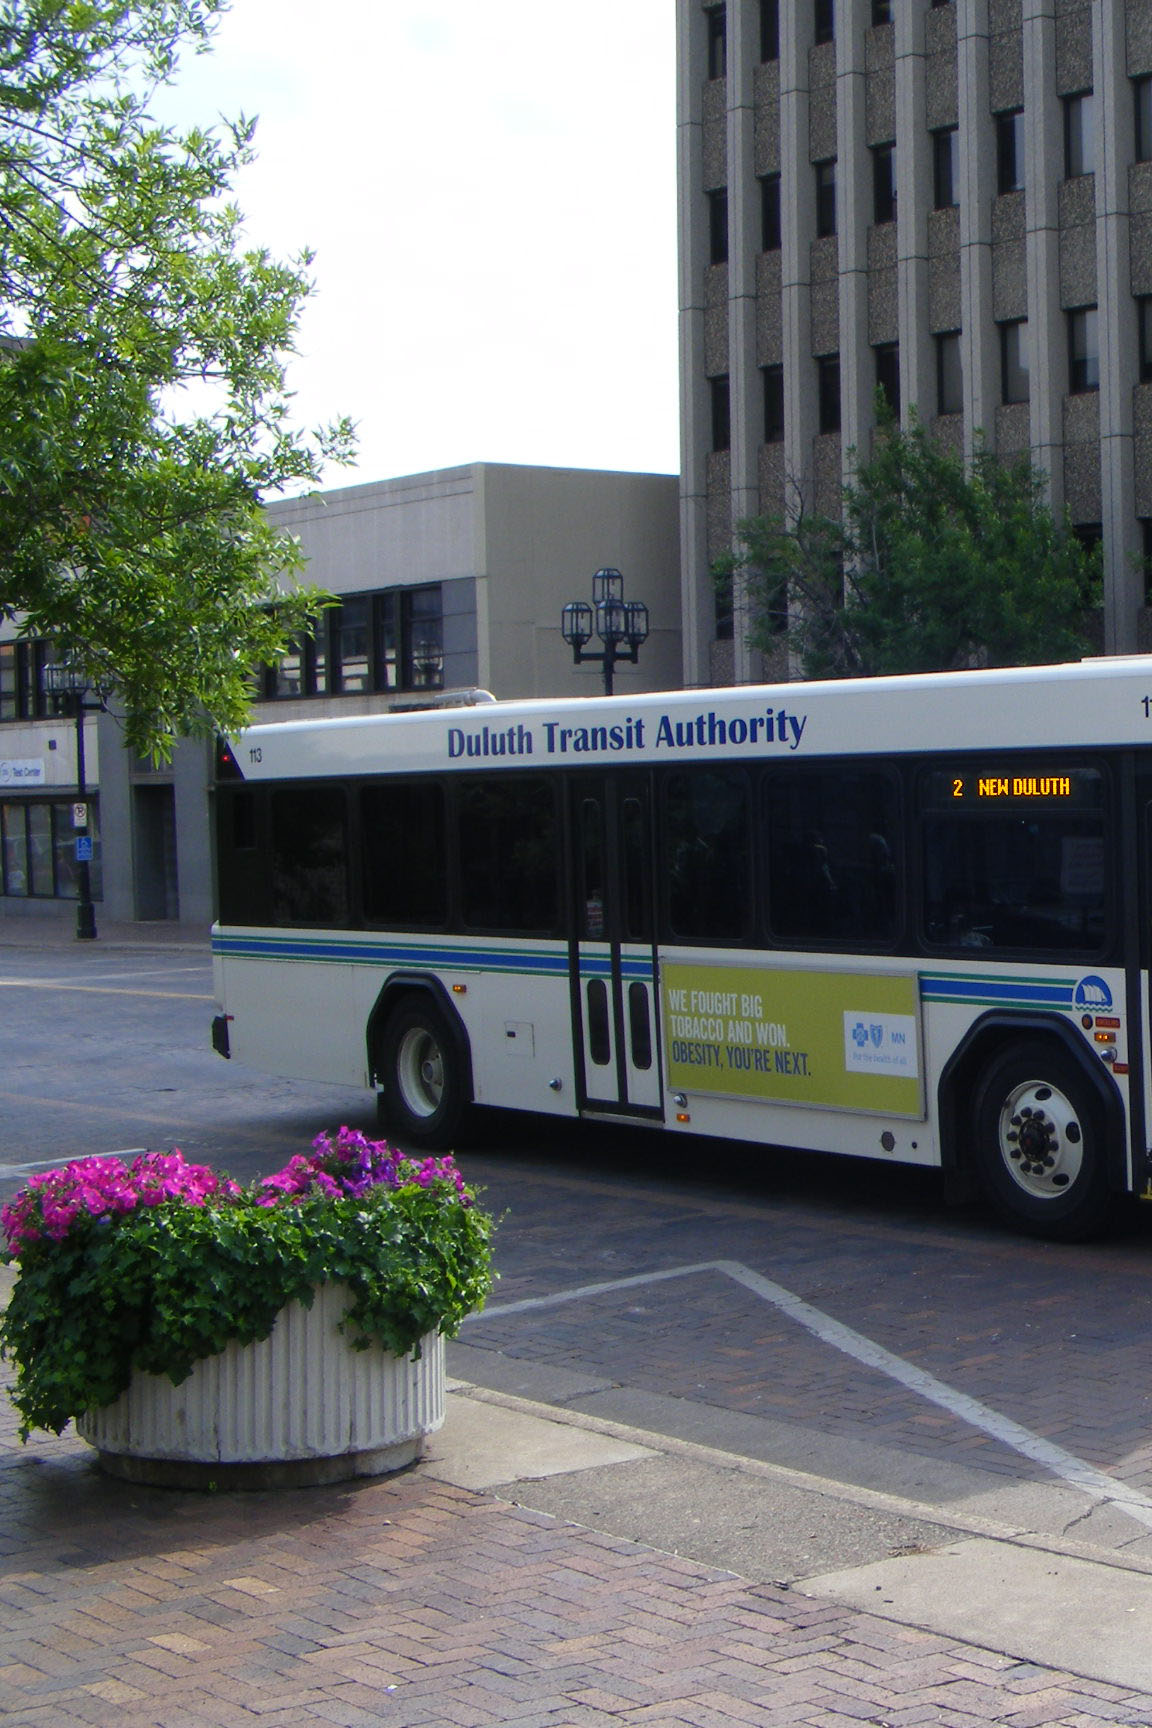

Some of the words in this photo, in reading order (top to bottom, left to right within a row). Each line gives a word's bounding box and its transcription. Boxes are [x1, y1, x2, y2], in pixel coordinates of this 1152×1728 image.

[447, 724, 532, 758] Duluth
[542, 717, 645, 754] Transit
[656, 708, 807, 750] Authority
[249, 747, 262, 763] 113
[953, 779, 963, 797] 2
[978, 778, 1009, 796] NEW
[1013, 777, 1070, 796] DULUTH
[669, 989, 688, 1012] WE
[690, 991, 737, 1016] FOUGHT
[741, 994, 763, 1018] BIG
[670, 1015, 723, 1041] TOBACCO
[728, 1020, 752, 1044] AND
[755, 1022, 790, 1048] WON.
[891, 1031, 906, 1045] MN
[672, 1040, 724, 1072] OBESITY,
[726, 1045, 772, 1072] YOU'RE
[774, 1050, 812, 1077] NEXT.
